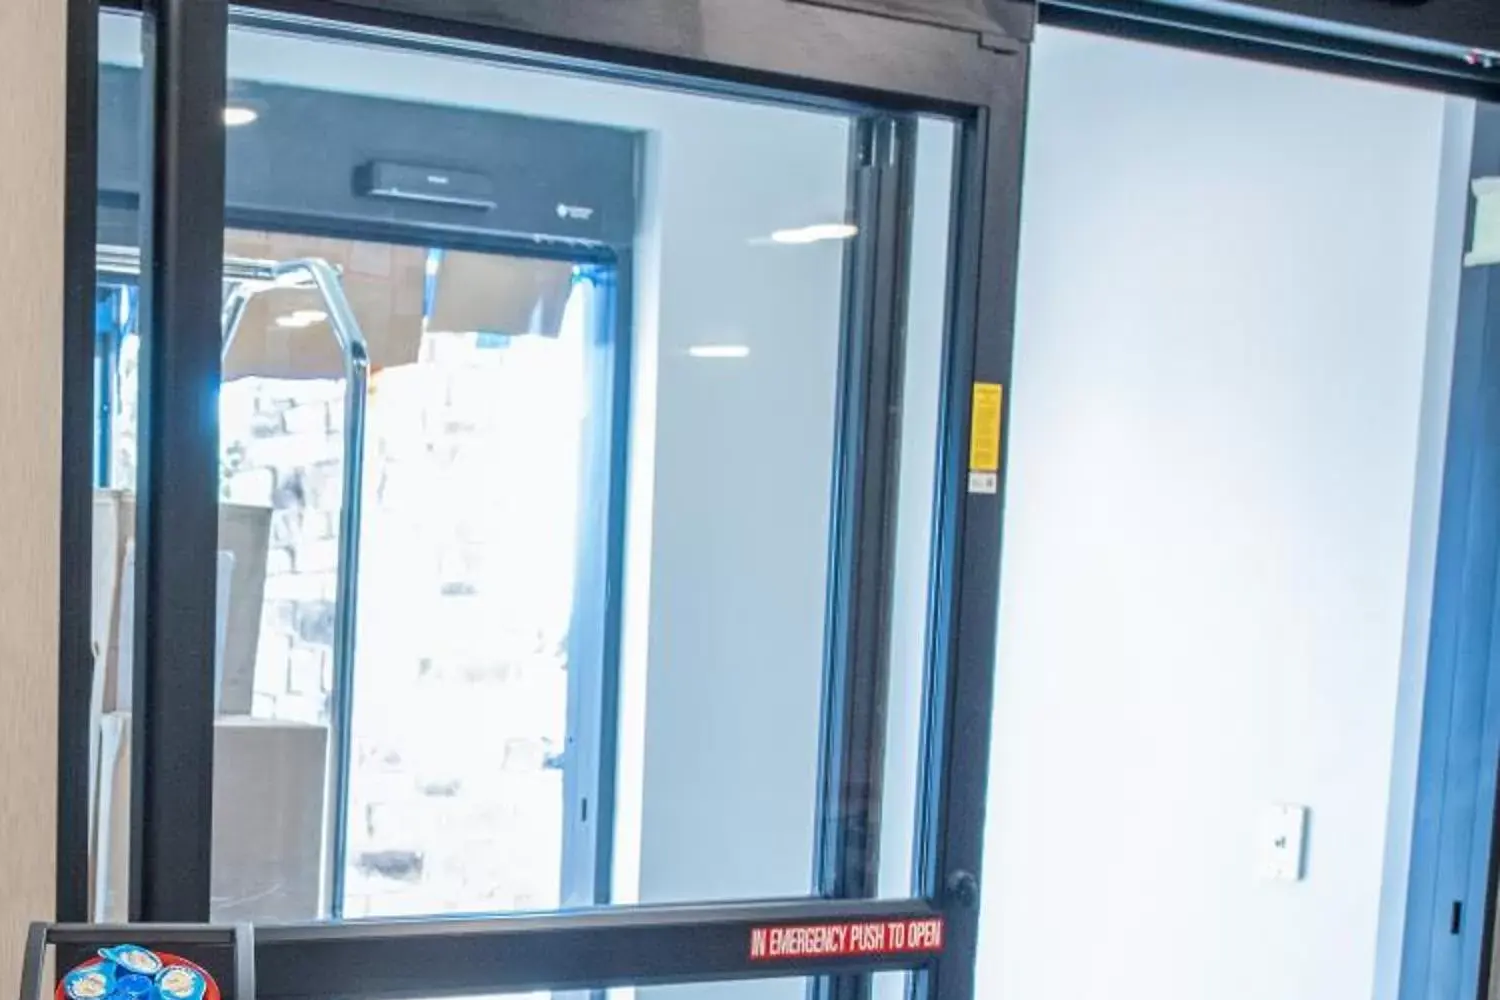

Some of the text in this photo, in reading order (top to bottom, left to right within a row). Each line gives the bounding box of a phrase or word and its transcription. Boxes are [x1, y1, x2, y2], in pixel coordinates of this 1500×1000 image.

[751, 919, 942, 957] IN EMERGENCY PUSH TO OPEN
